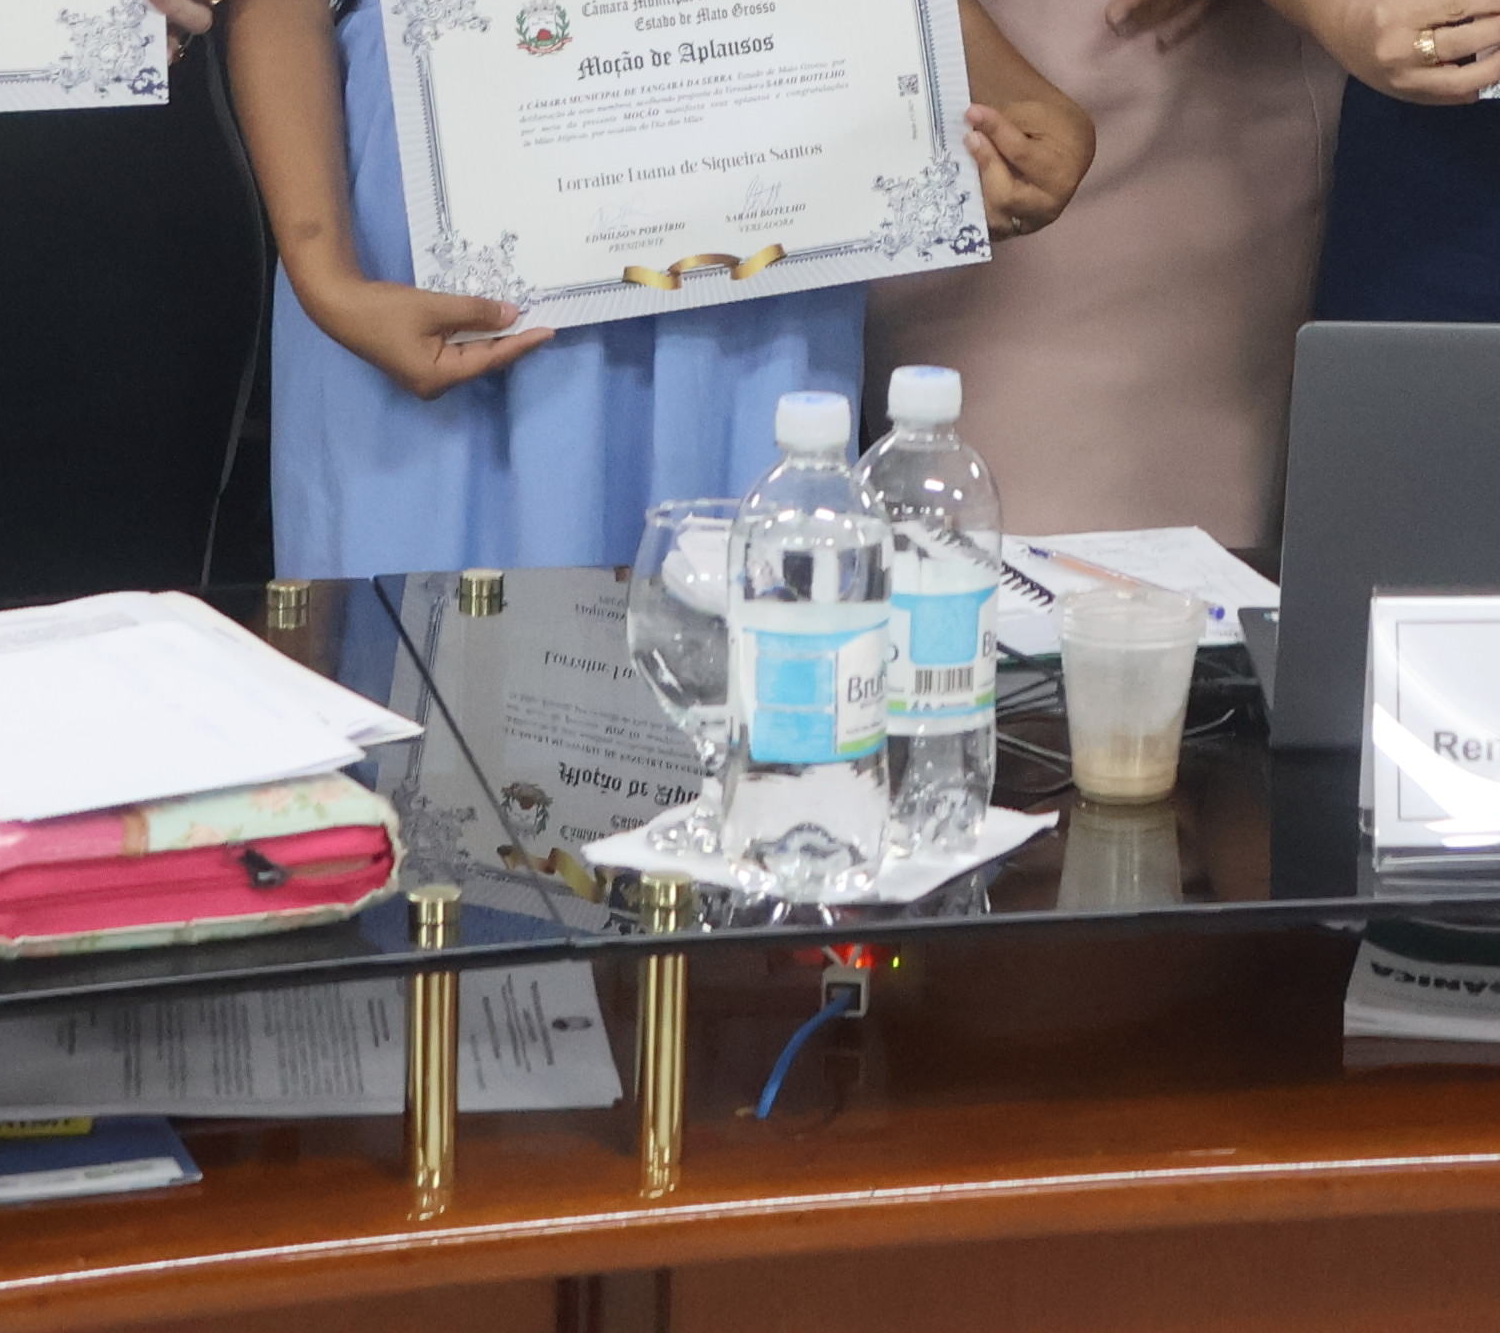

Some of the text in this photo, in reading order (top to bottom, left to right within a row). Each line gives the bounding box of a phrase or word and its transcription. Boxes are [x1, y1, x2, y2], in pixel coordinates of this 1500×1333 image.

[581, 0, 629, 18] Câmara
[634, 1, 776, 32] Estado de Mato Grosso
[577, 33, 775, 81] Moção de Aplausos
[680, 159, 698, 175] de
[701, 151, 766, 174] Siqueira
[769, 144, 823, 161] Santos
